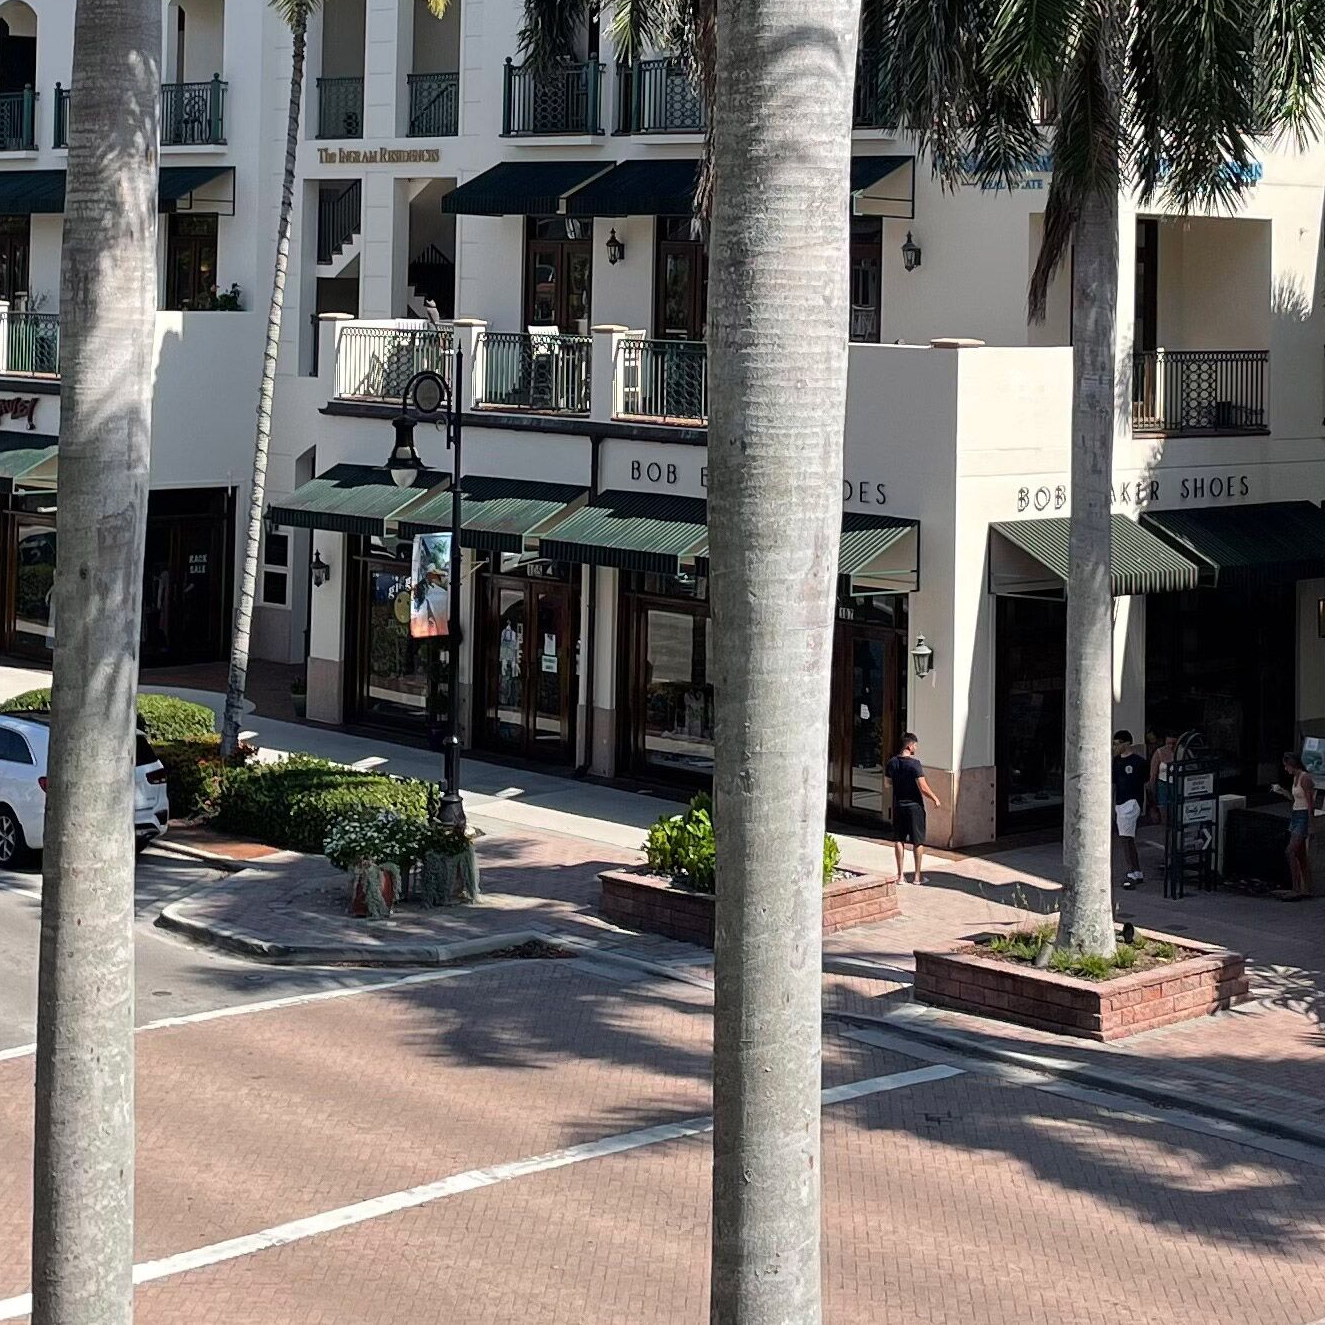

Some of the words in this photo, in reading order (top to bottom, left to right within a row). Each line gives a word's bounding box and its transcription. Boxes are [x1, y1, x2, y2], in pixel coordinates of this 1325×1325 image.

[631, 461, 677, 484] BOB
[1017, 484, 1067, 512] BOB
[1180, 475, 1250, 499] SHOES
